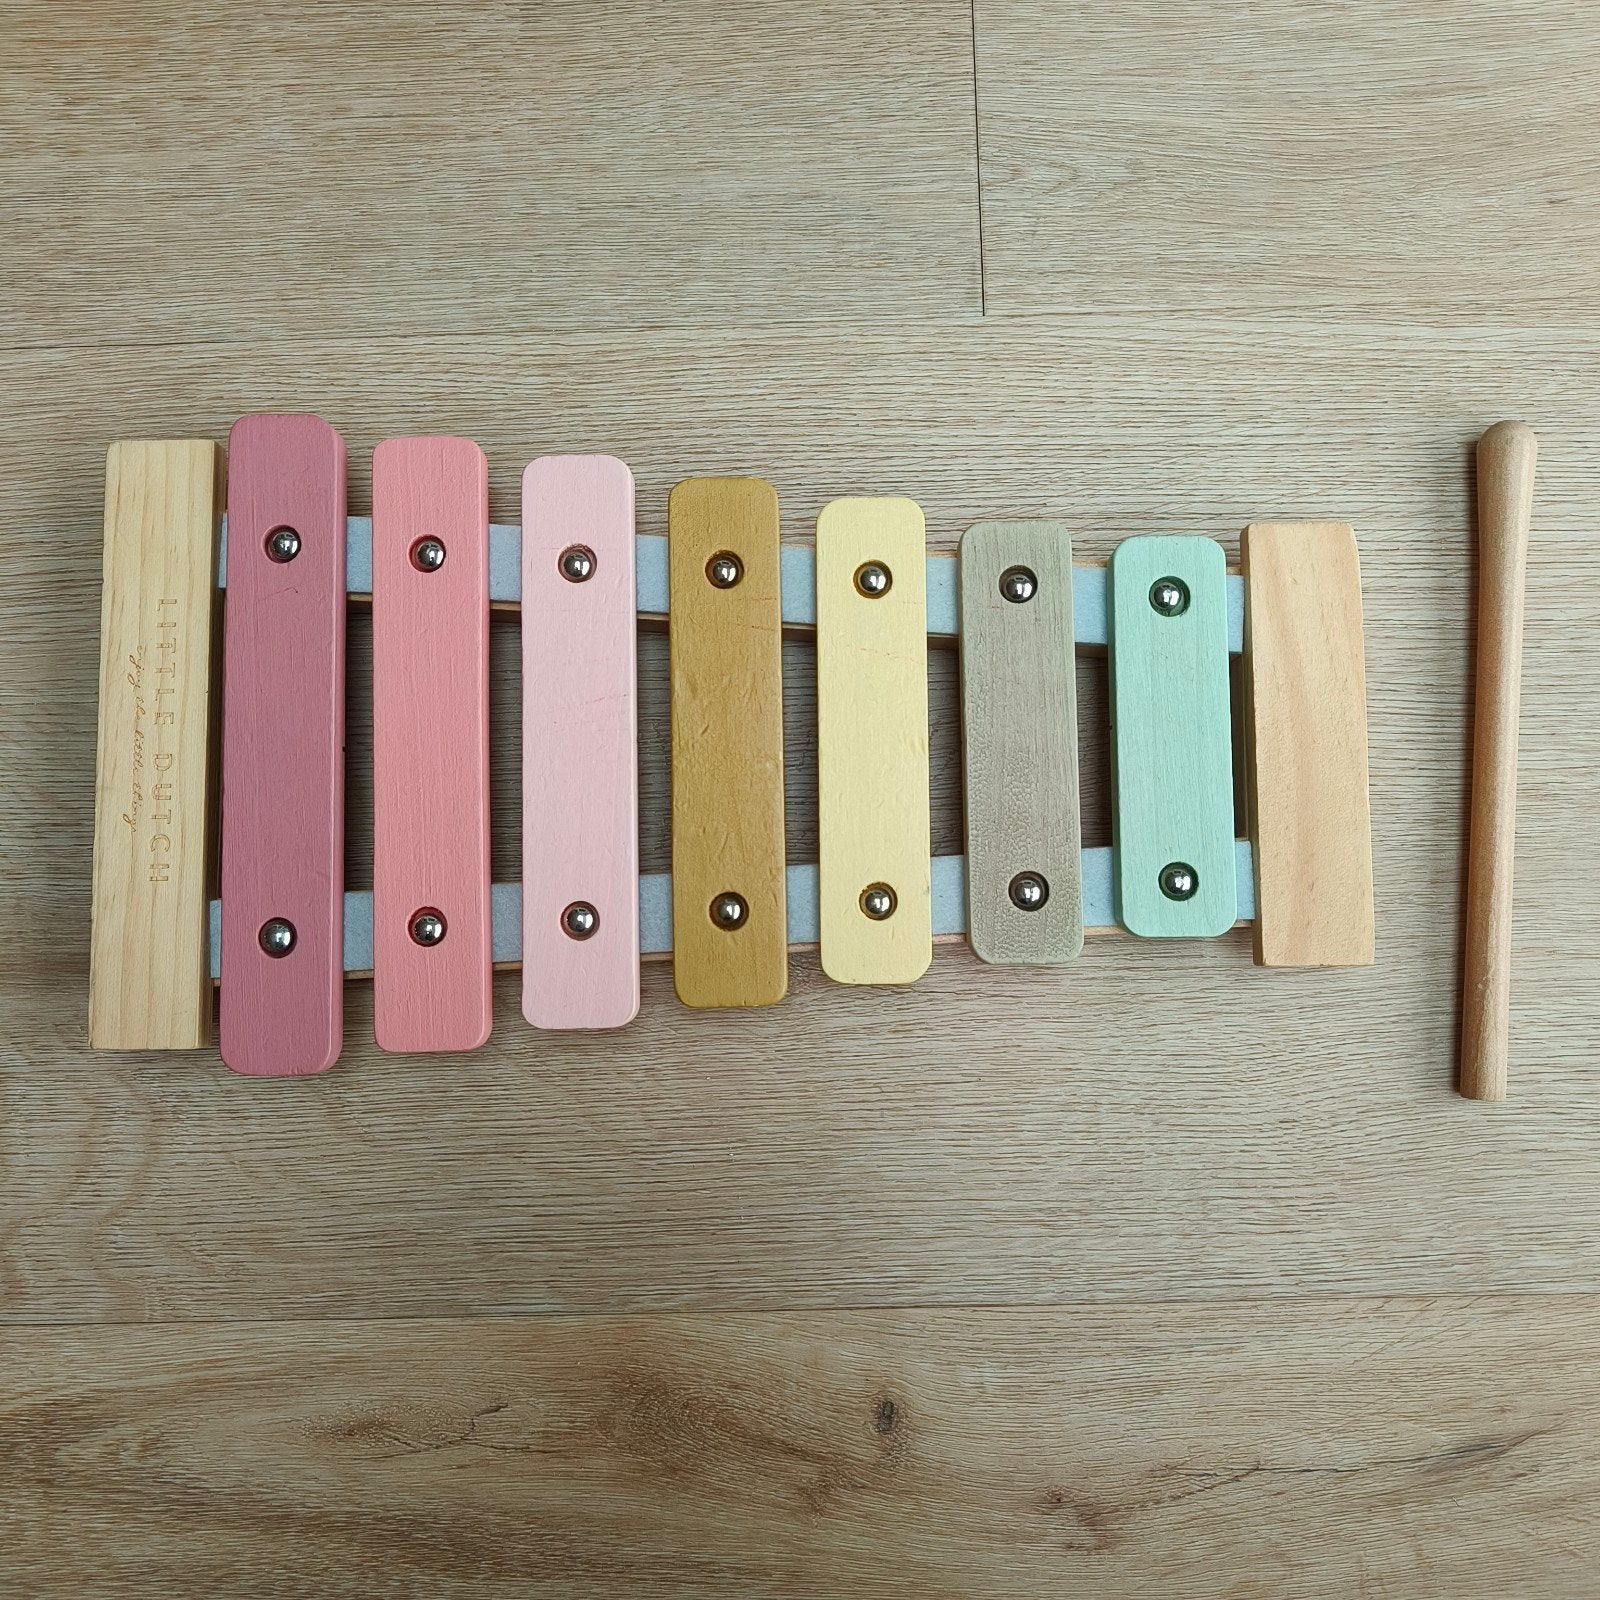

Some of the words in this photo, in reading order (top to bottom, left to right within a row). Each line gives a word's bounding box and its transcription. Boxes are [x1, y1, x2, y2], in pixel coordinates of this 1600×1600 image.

[127, 644, 146, 689] enjoy
[154, 598, 178, 725] LITTLE
[135, 697, 146, 721] the
[133, 729, 145, 776] little
[122, 783, 143, 833] things
[149, 753, 173, 882] DUTCH
